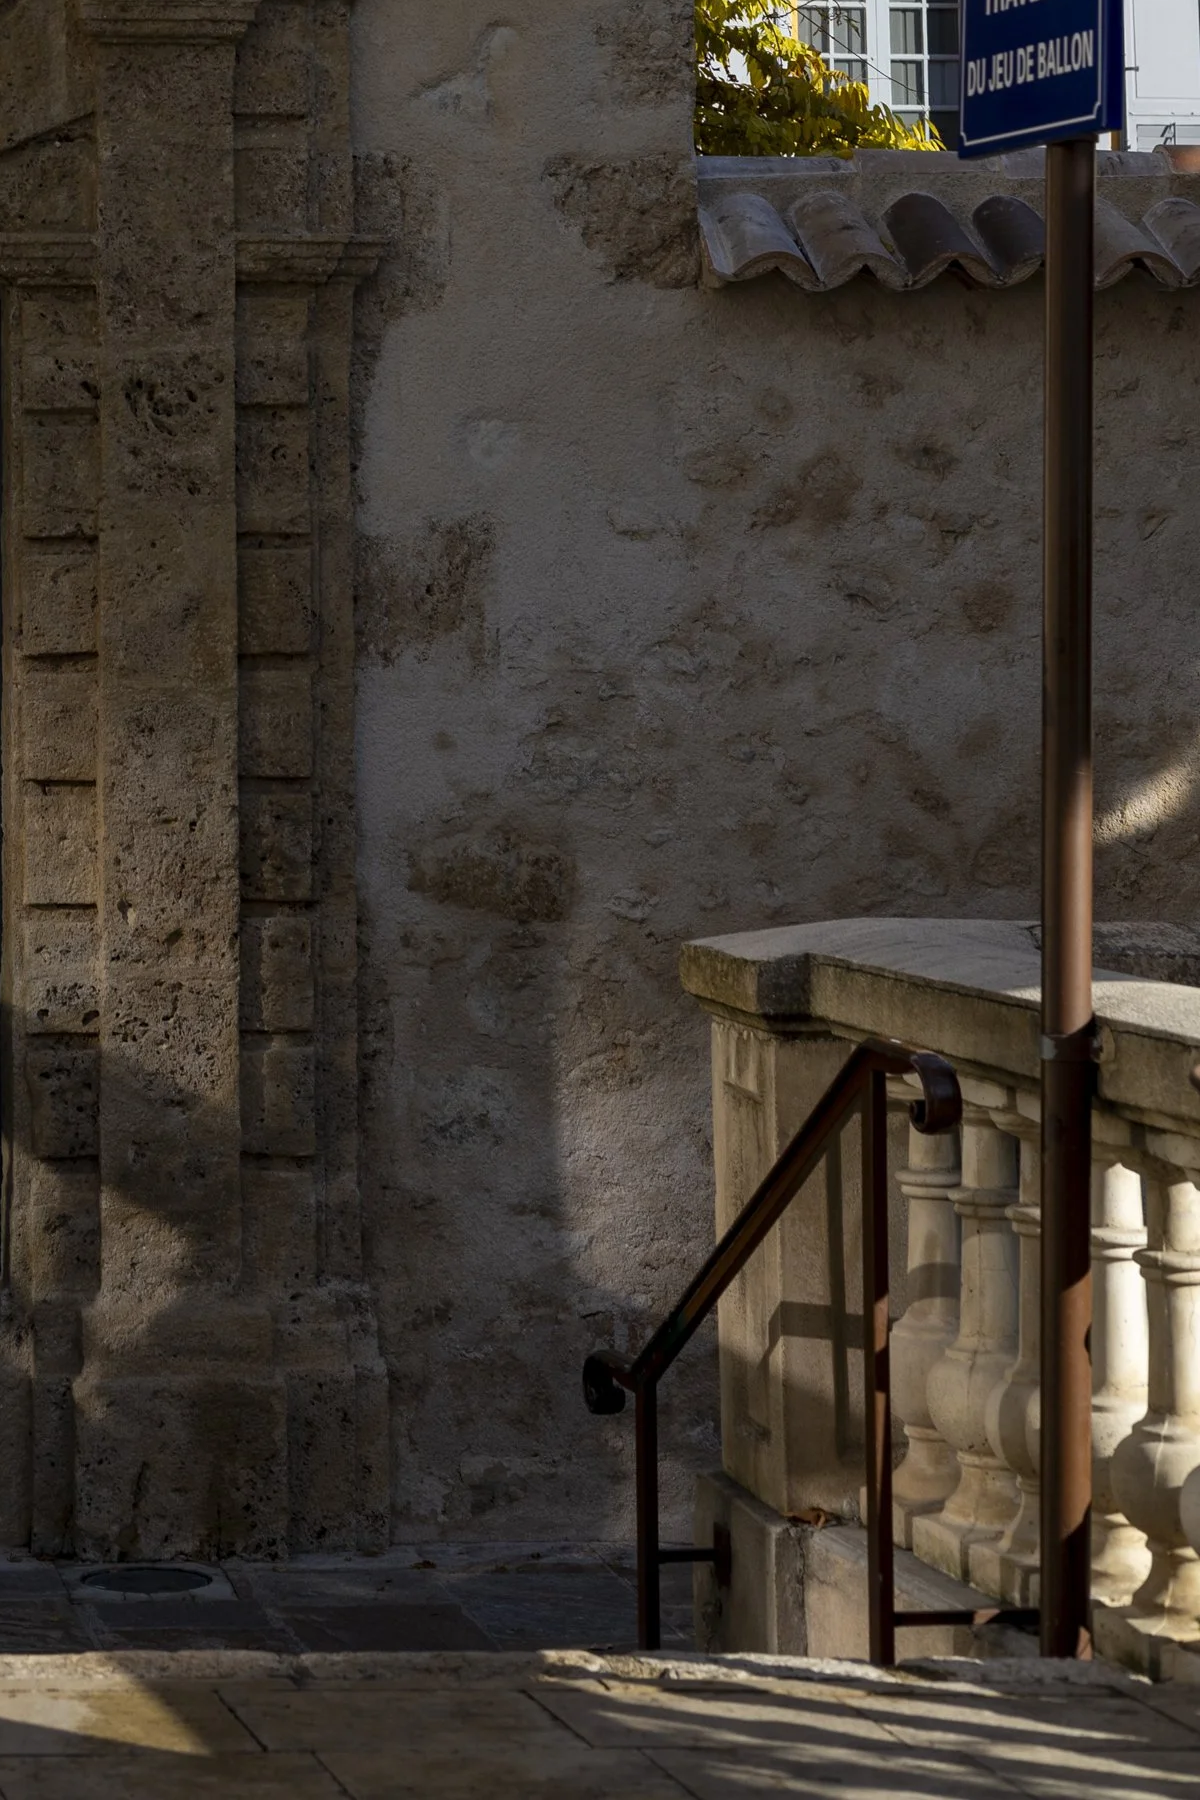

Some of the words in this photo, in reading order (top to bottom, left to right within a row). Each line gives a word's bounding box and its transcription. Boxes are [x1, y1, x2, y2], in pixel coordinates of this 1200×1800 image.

[967, 58, 986, 97] DU
[988, 51, 1014, 92] JEU
[1016, 45, 1035, 85] DE
[1037, 30, 1094, 80] BALLON
